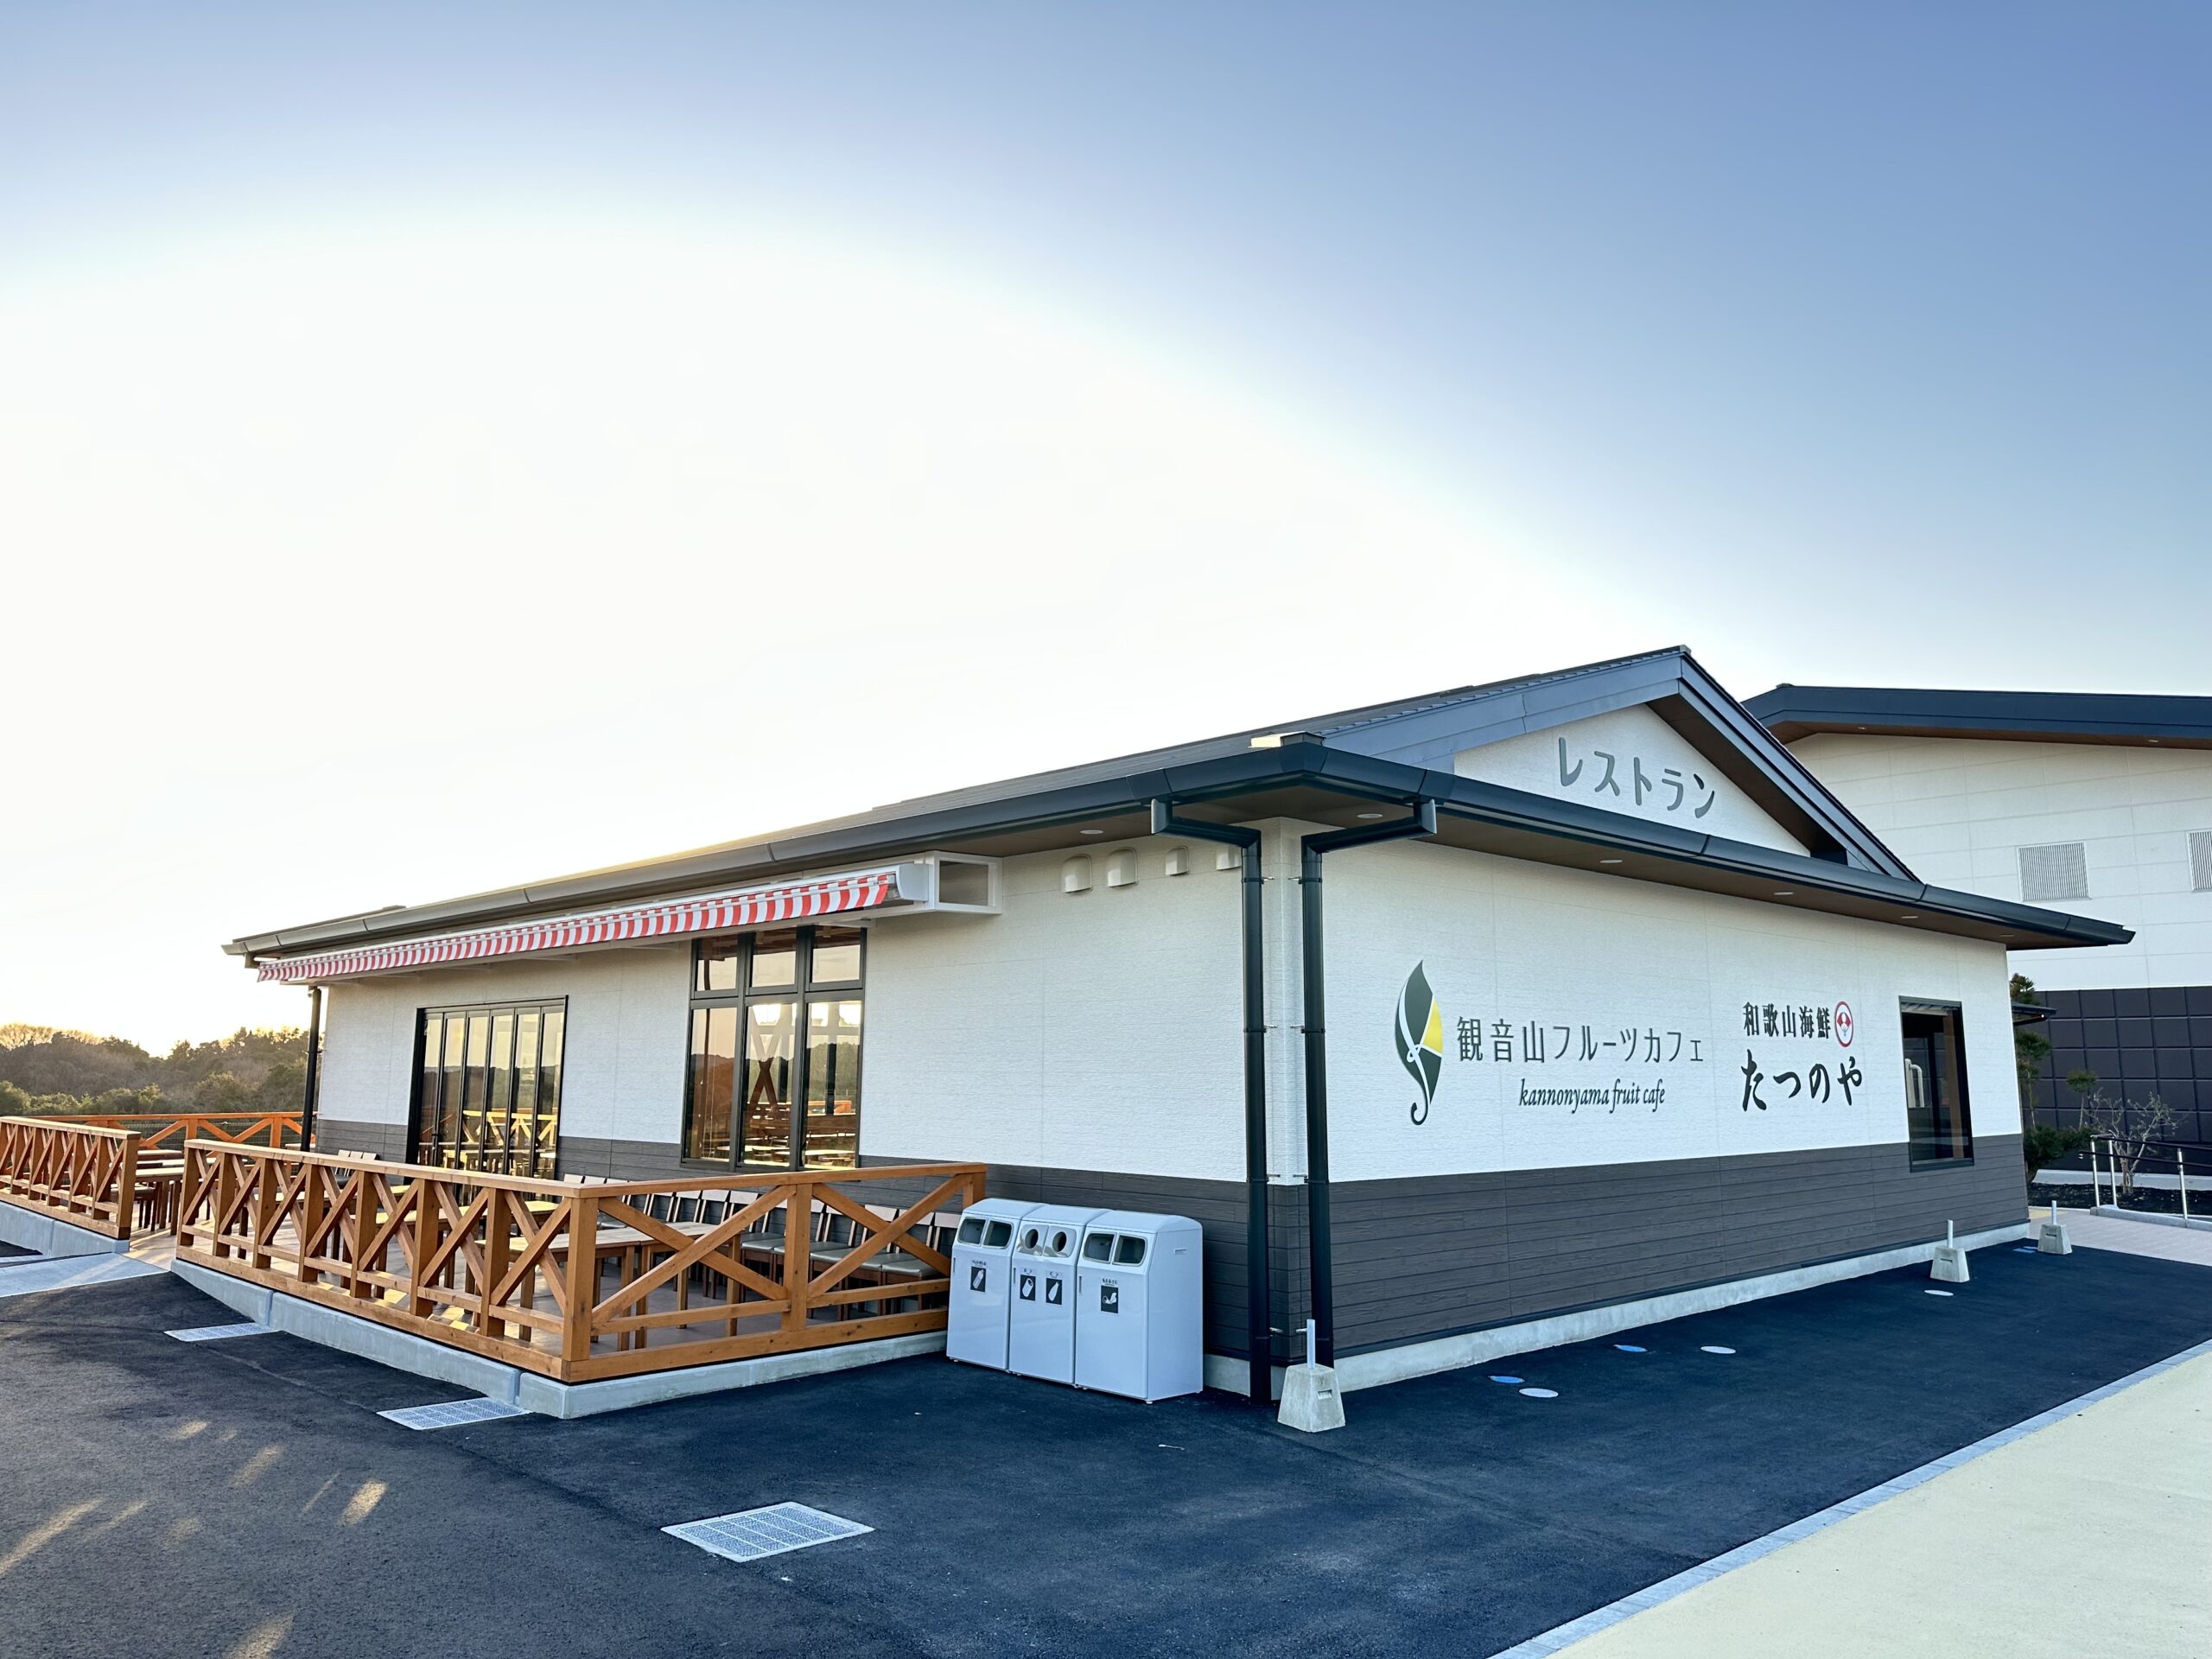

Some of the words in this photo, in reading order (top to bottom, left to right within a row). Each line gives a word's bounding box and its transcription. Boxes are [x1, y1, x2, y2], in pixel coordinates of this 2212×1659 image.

[1559, 737, 1715, 819] レストラン
[1457, 1015, 1704, 1064] 観音山フルーツカフェ
[1742, 1001, 1832, 1039] 和歌山海鮮
[1518, 1077, 1610, 1115] kannonyama
[1609, 1077, 1641, 1115] fruit
[1643, 1077, 1666, 1113] cafe
[1740, 1048, 1864, 1113] たつのや
